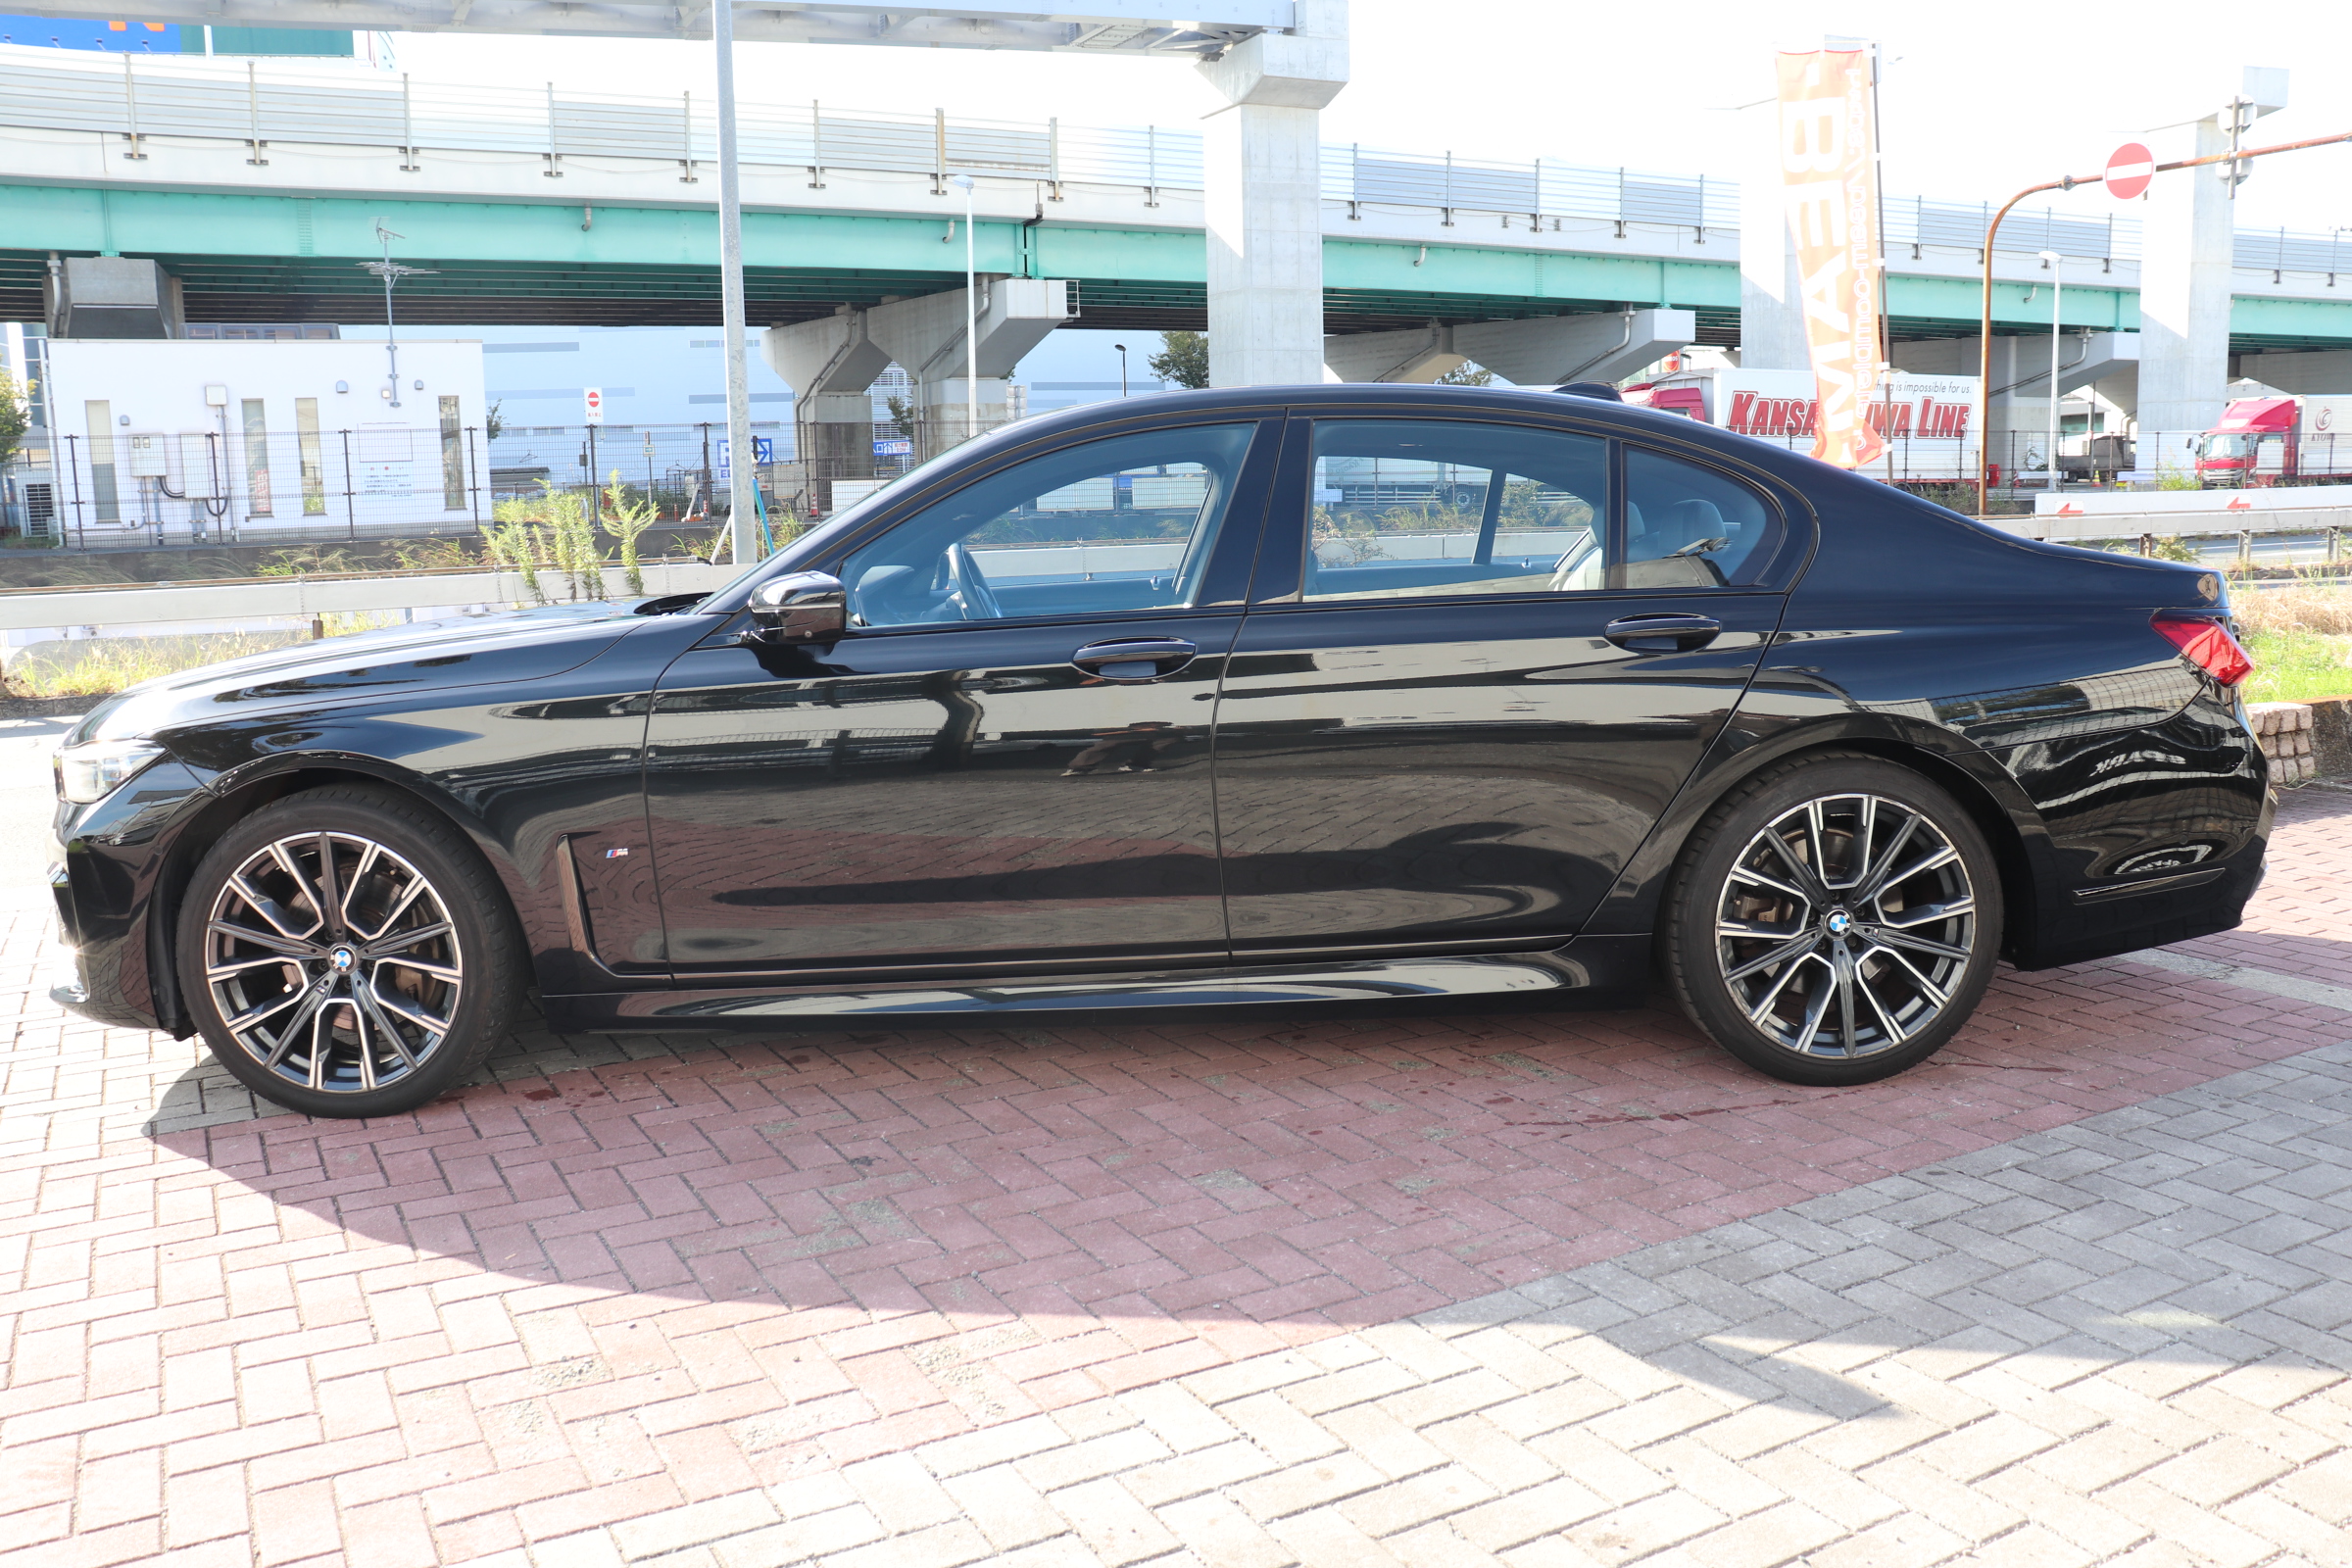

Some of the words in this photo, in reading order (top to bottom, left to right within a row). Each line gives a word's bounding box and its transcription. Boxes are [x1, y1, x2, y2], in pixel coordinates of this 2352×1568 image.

[1903, 380, 1946, 395] impossible
[1948, 380, 1960, 393] for
[1915, 396, 1972, 440] LINE
